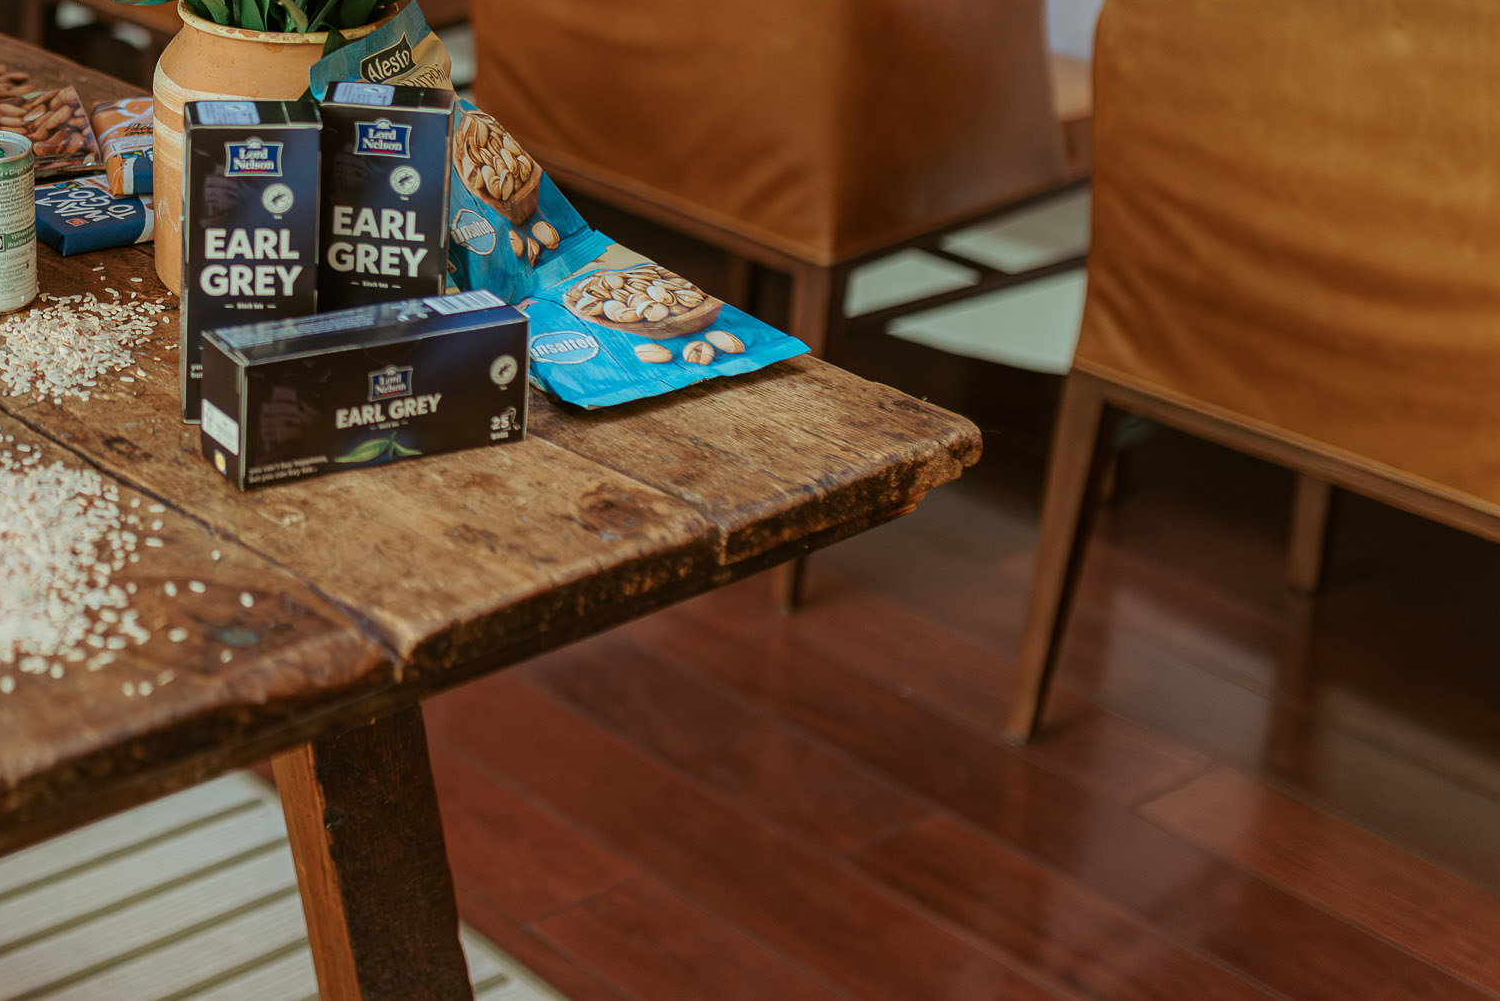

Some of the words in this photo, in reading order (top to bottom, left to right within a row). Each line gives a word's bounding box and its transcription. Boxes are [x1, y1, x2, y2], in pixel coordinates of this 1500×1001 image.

[368, 49, 410, 83] Alesto
[362, 137, 403, 151] Nelson
[368, 128, 397, 140] Lord
[233, 157, 275, 170] Nelson
[239, 147, 268, 160] Lord
[35, 197, 111, 222] WAY
[106, 204, 137, 220] TO
[333, 205, 425, 242] EARL
[205, 228, 300, 260] EARL
[327, 241, 428, 278] GREY
[200, 264, 303, 297] GREY
[335, 402, 386, 430] EARL
[388, 393, 443, 420] GREY
[491, 416, 509, 431] 25
